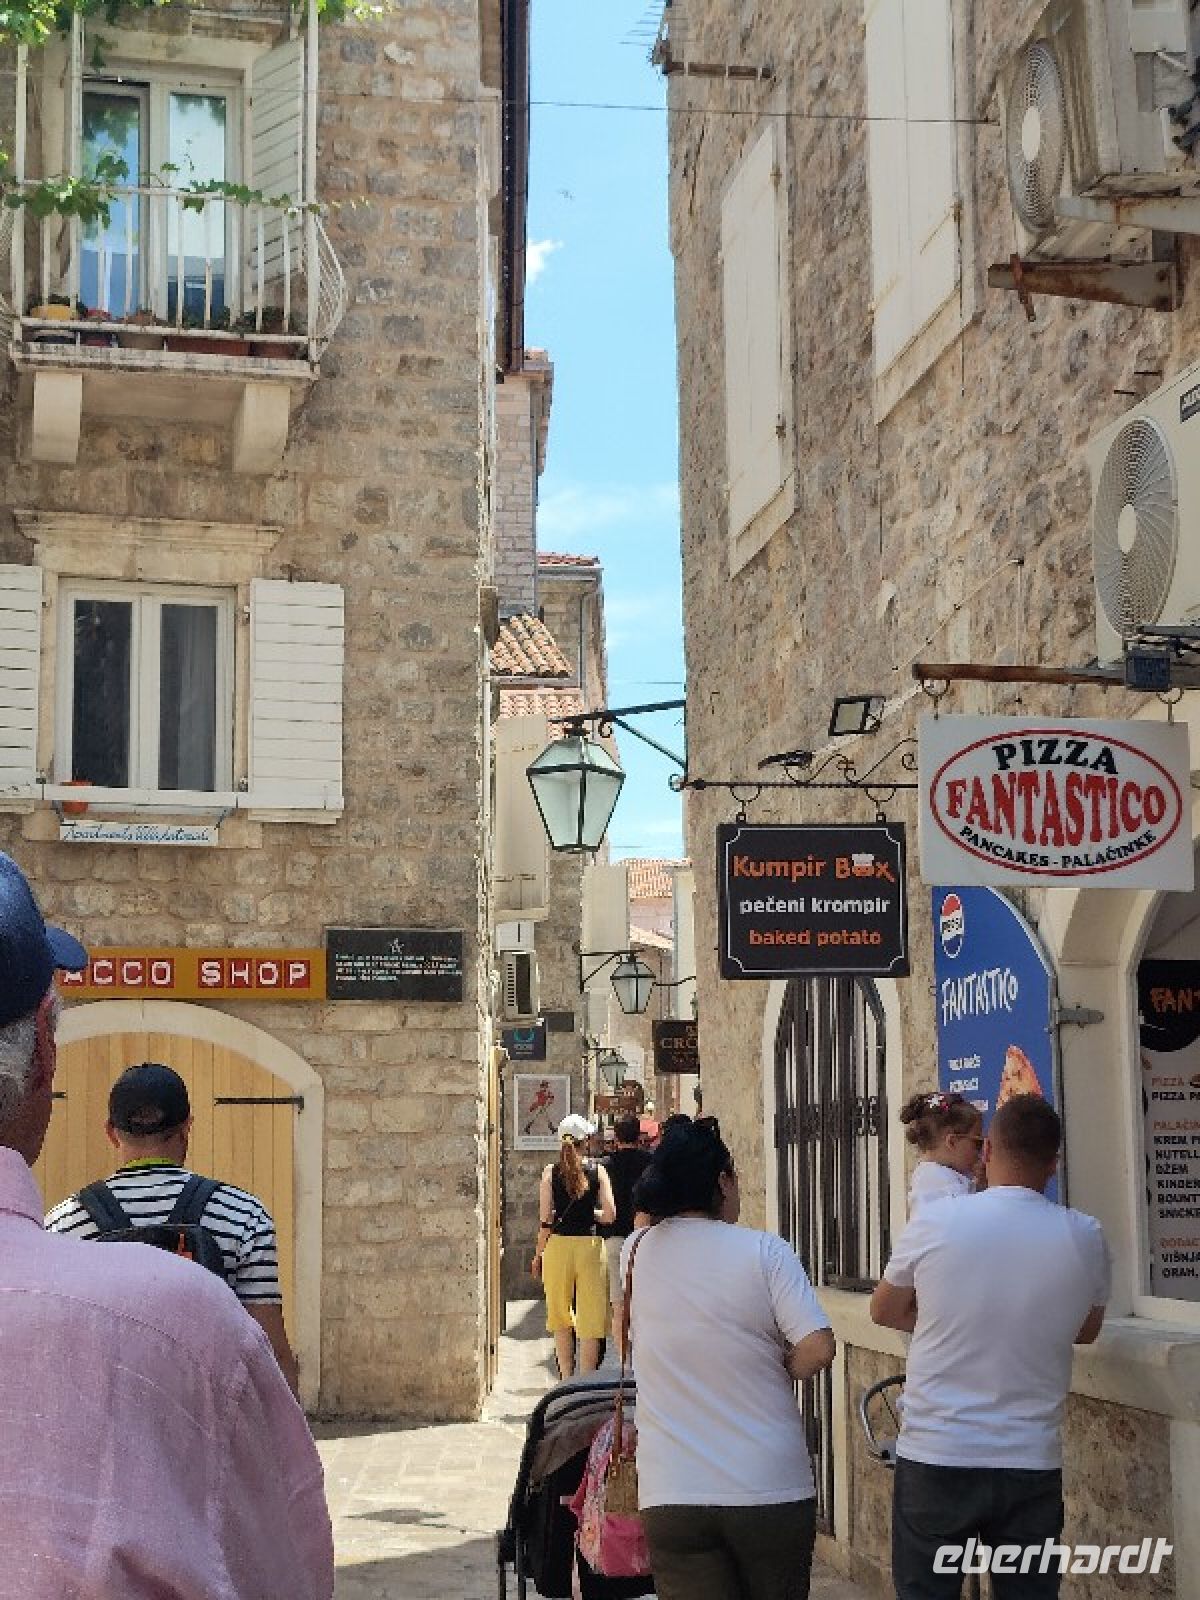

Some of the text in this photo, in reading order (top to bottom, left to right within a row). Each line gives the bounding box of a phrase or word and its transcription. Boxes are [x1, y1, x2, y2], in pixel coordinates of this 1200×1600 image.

[992, 738, 1118, 774] PIZZA
[946, 770, 1166, 847] FANTASTICO
[733, 854, 827, 883] Kumpir
[739, 896, 891, 914] pečeni krompir
[749, 929, 882, 946] baked potato
[201, 961, 307, 986] SHOP
[1152, 1077, 1184, 1087] PIZZA
[1152, 1091, 1185, 1101] PIZZA
[1155, 1149, 1200, 1160] NUTELL
[1155, 1162, 1189, 1175] DŽEM
[1158, 1193, 1200, 1204] BOUNT
